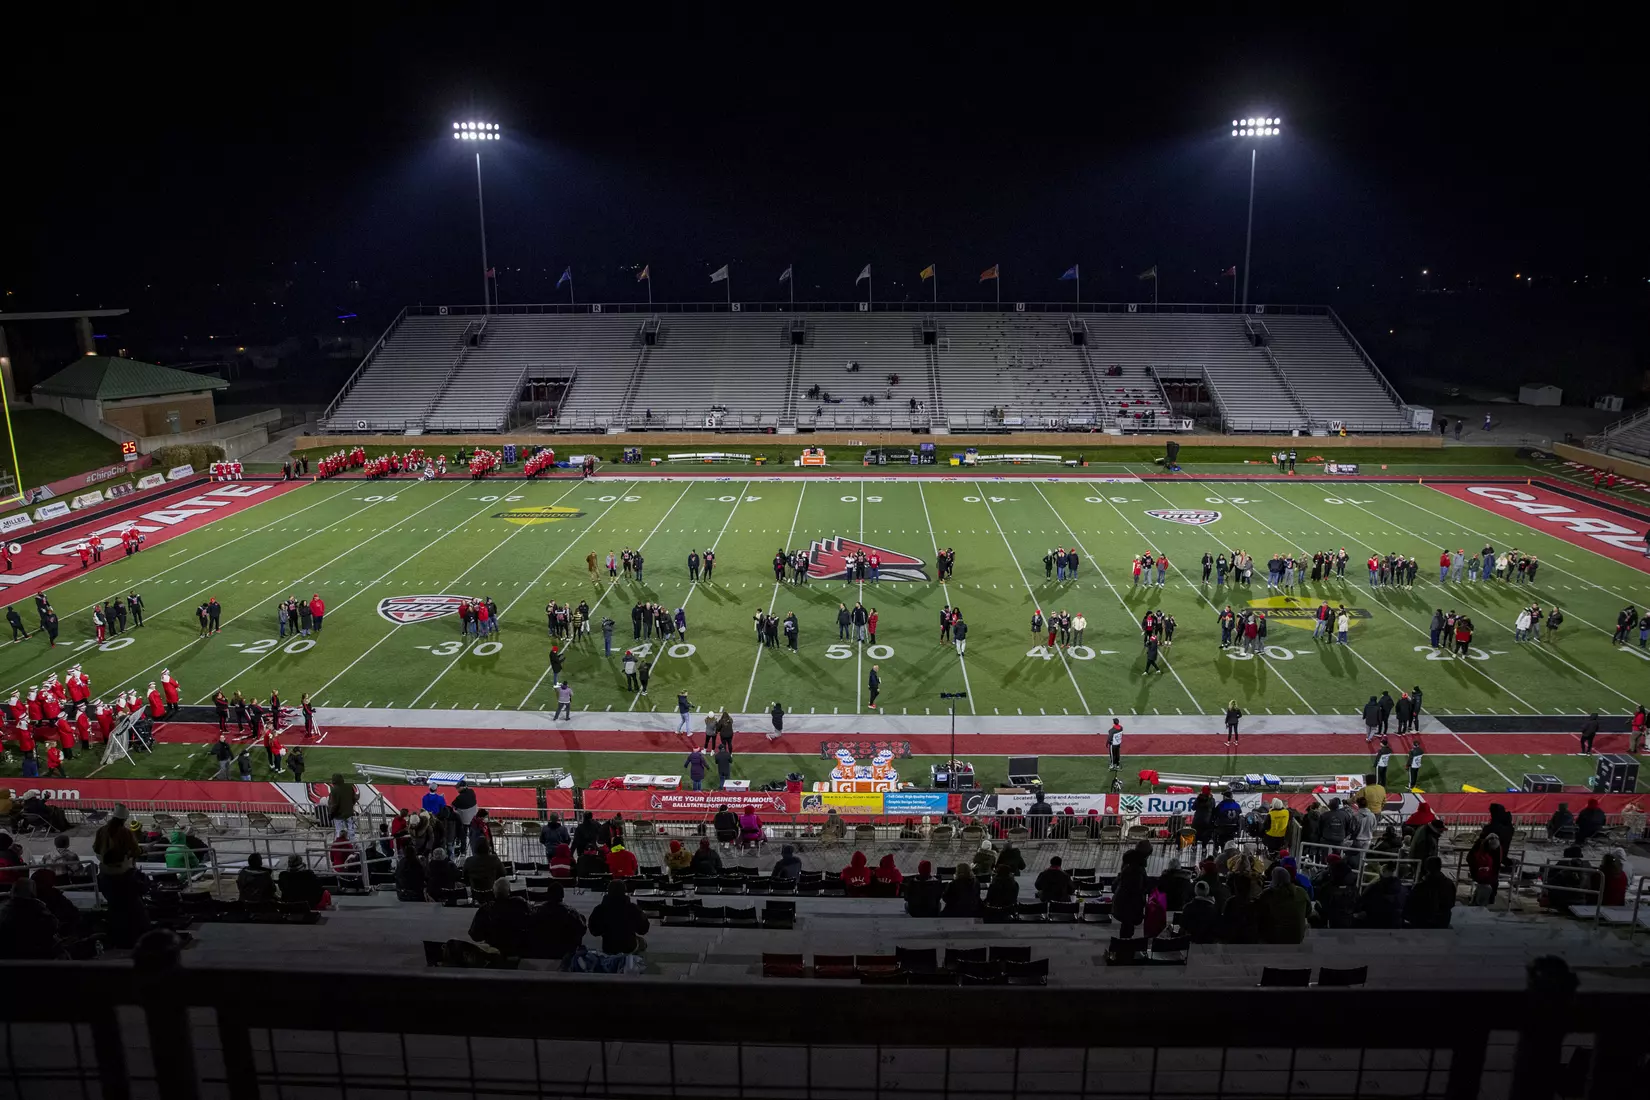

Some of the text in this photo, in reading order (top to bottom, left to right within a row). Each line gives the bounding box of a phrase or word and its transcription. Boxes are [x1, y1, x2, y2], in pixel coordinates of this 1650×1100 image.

[358, 421, 366, 429] Q
[707, 419, 713, 427] S
[1050, 419, 1057, 428] U
[1183, 420, 1191, 428] V
[1332, 421, 1341, 429] W
[123, 442, 136, 454] 25
[86, 465, 128, 483] #ChirpChir
[3, 516, 26, 526] MILLER
[38, 484, 275, 557] STATE
[239, 638, 317, 654] 20
[431, 641, 504, 656] 30
[824, 644, 895, 660] 50
[1026, 645, 1096, 661] 40
[962, 794, 991, 815] Gill
